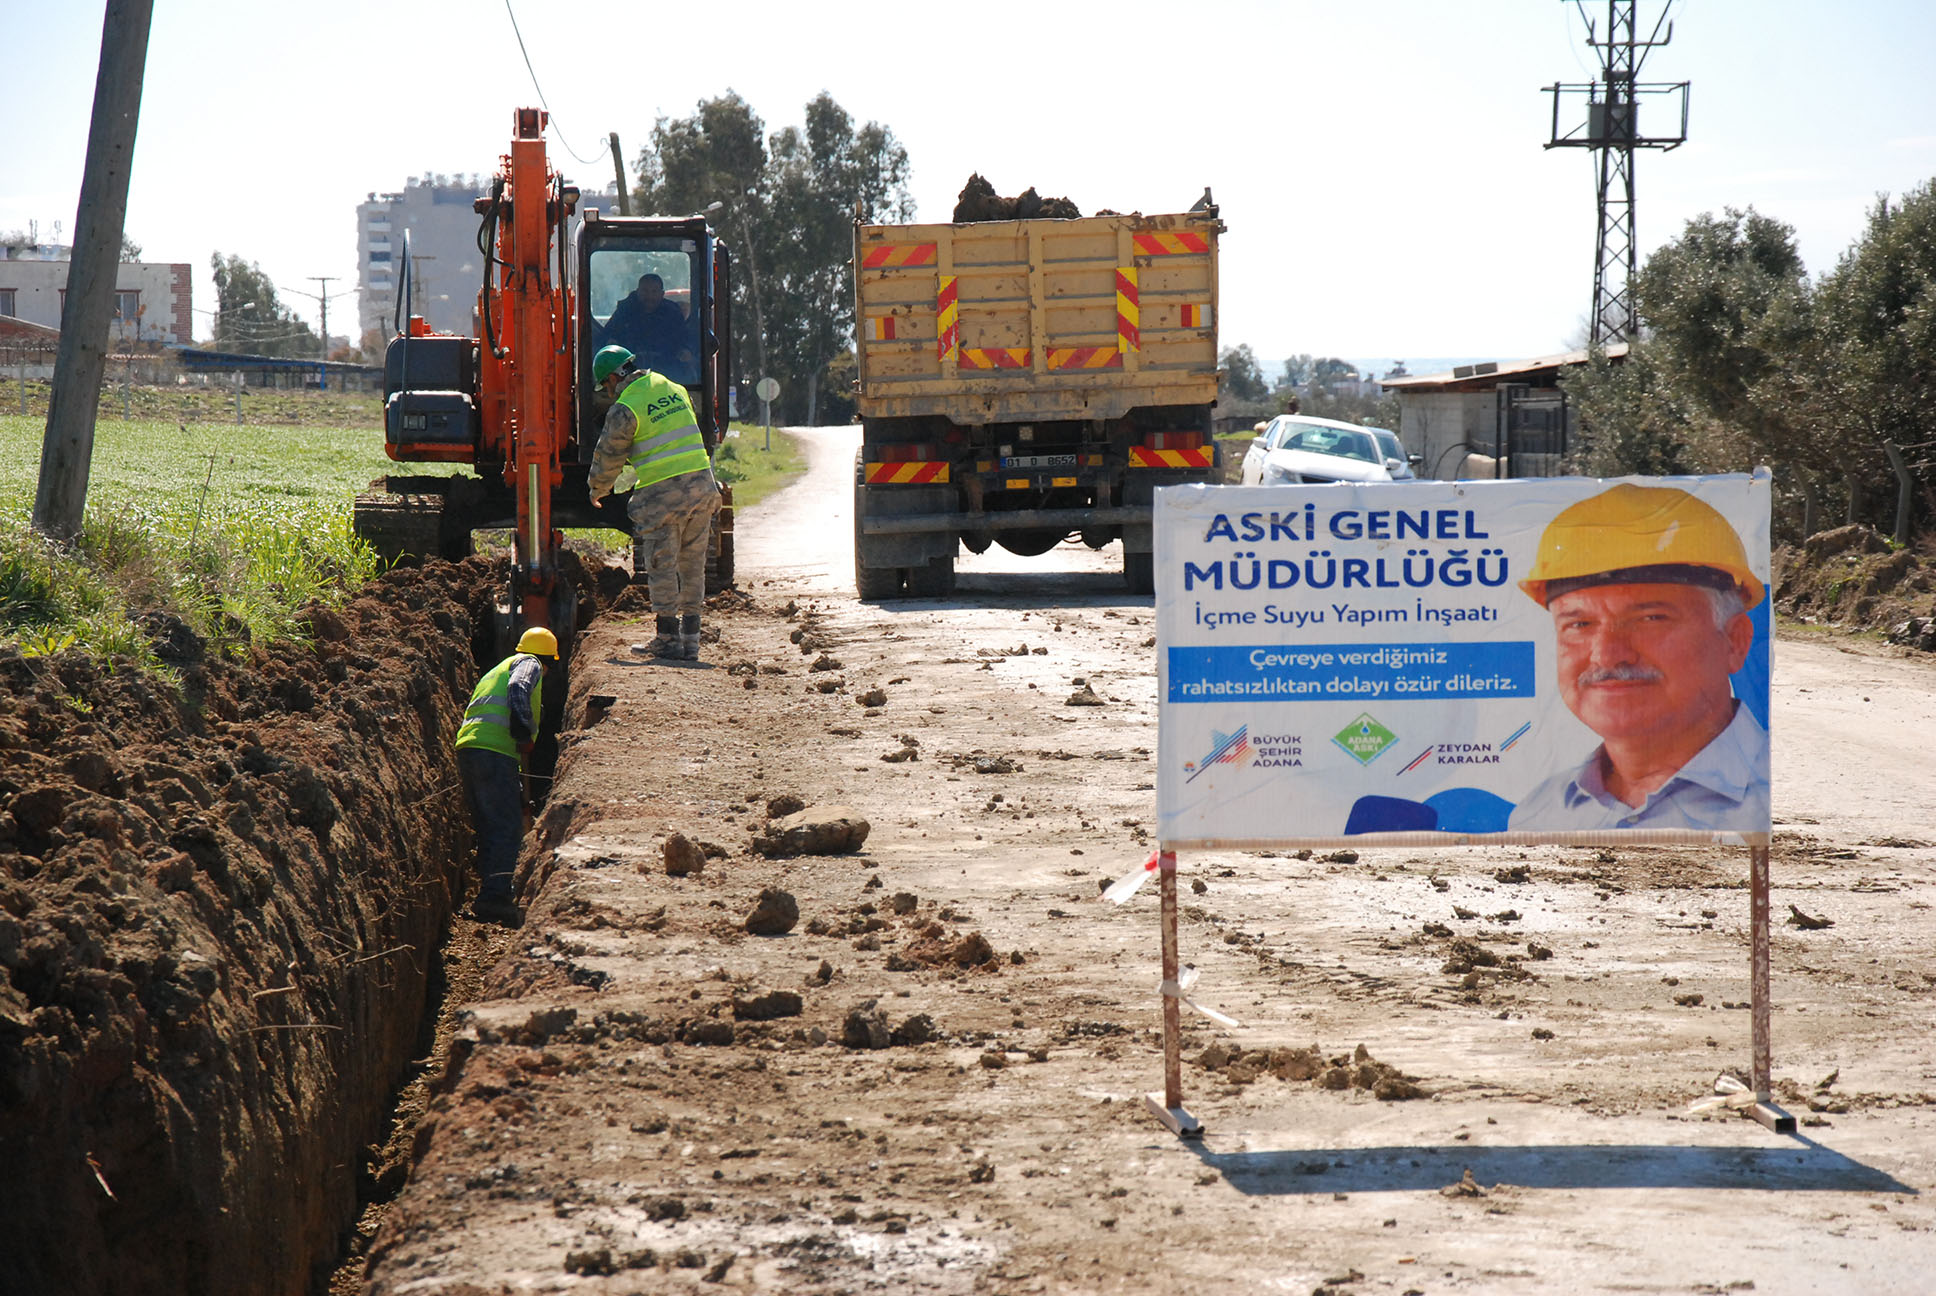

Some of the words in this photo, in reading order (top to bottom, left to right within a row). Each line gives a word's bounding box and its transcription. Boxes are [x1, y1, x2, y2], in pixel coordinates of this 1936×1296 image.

[1007, 458, 1020, 467] 01
[1047, 456, 1075, 465] 8652
[1203, 503, 1315, 542] ASKİ
[1329, 510, 1489, 540] GENEL
[1184, 549, 1509, 591] MÜDÜRLÜĞÜ
[1195, 601, 1257, 630] İçme
[1264, 605, 1325, 628] Suyu
[1332, 603, 1408, 628] Yapım
[1416, 598, 1498, 626] İnşaatı
[1250, 649, 1334, 670] Çevreye
[1338, 647, 1448, 669] verdiğimiz
[1182, 677, 1321, 696] rahatsızlıktan
[1326, 676, 1389, 697] dolayı
[1394, 675, 1442, 693] özür
[1445, 674, 1517, 692] dileriz.
[1252, 734, 1302, 745] BÜYÜK
[1348, 736, 1383, 745] ADANA
[1258, 746, 1302, 759] ŞEHİR
[1437, 743, 1492, 753] ZEYDAN
[1252, 758, 1303, 767] ADANA
[1437, 755, 1500, 764] KARALAR
